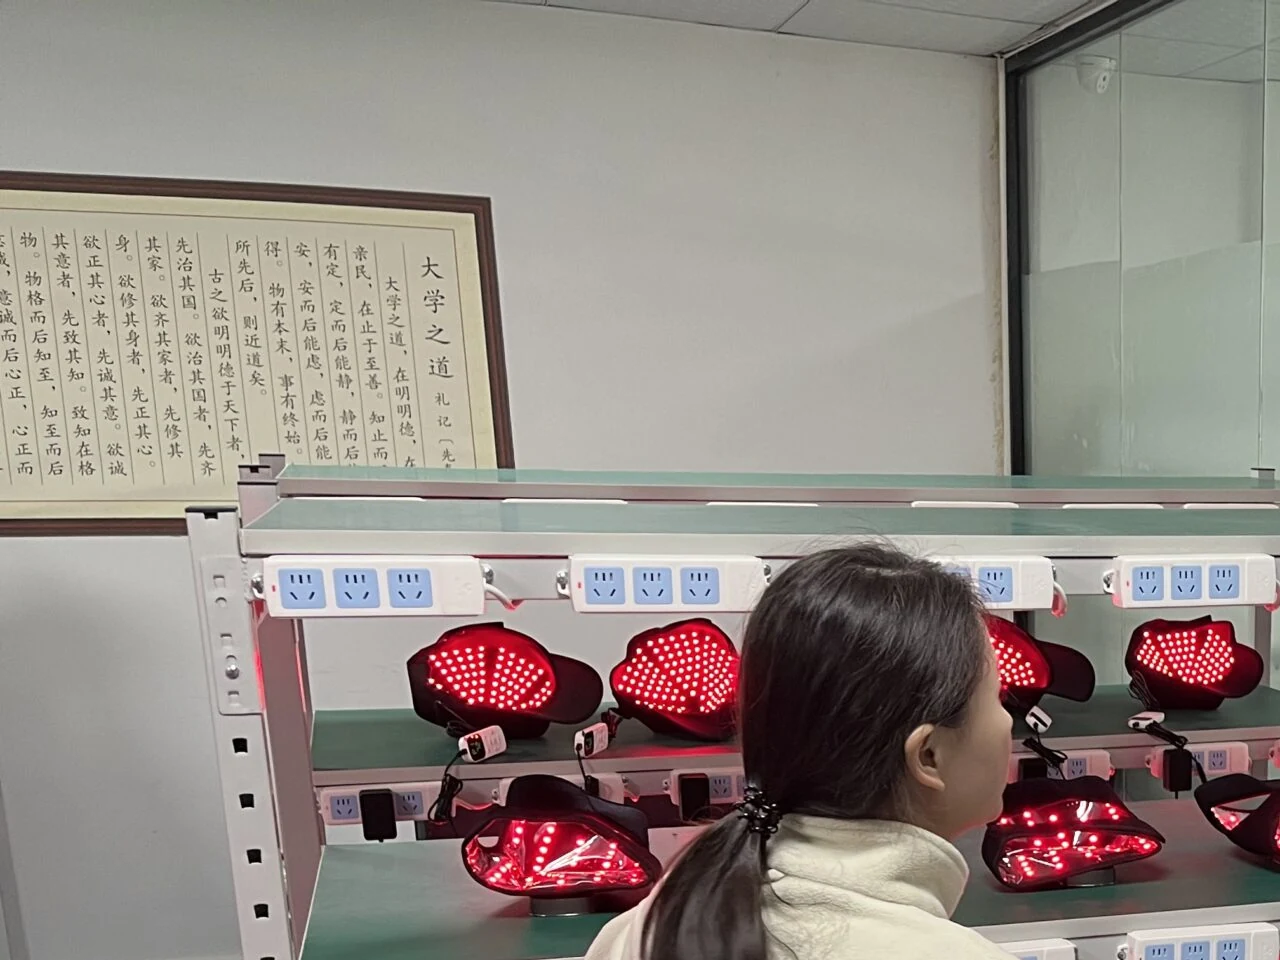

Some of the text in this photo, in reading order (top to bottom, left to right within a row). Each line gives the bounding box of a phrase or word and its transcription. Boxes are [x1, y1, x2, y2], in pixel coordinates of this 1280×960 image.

[323, 243, 359, 467] 有定，定而后能静，静而后
[353, 245, 388, 467] 亲民，在止于至善。知止而
[421, 256, 454, 378] 大学之道
